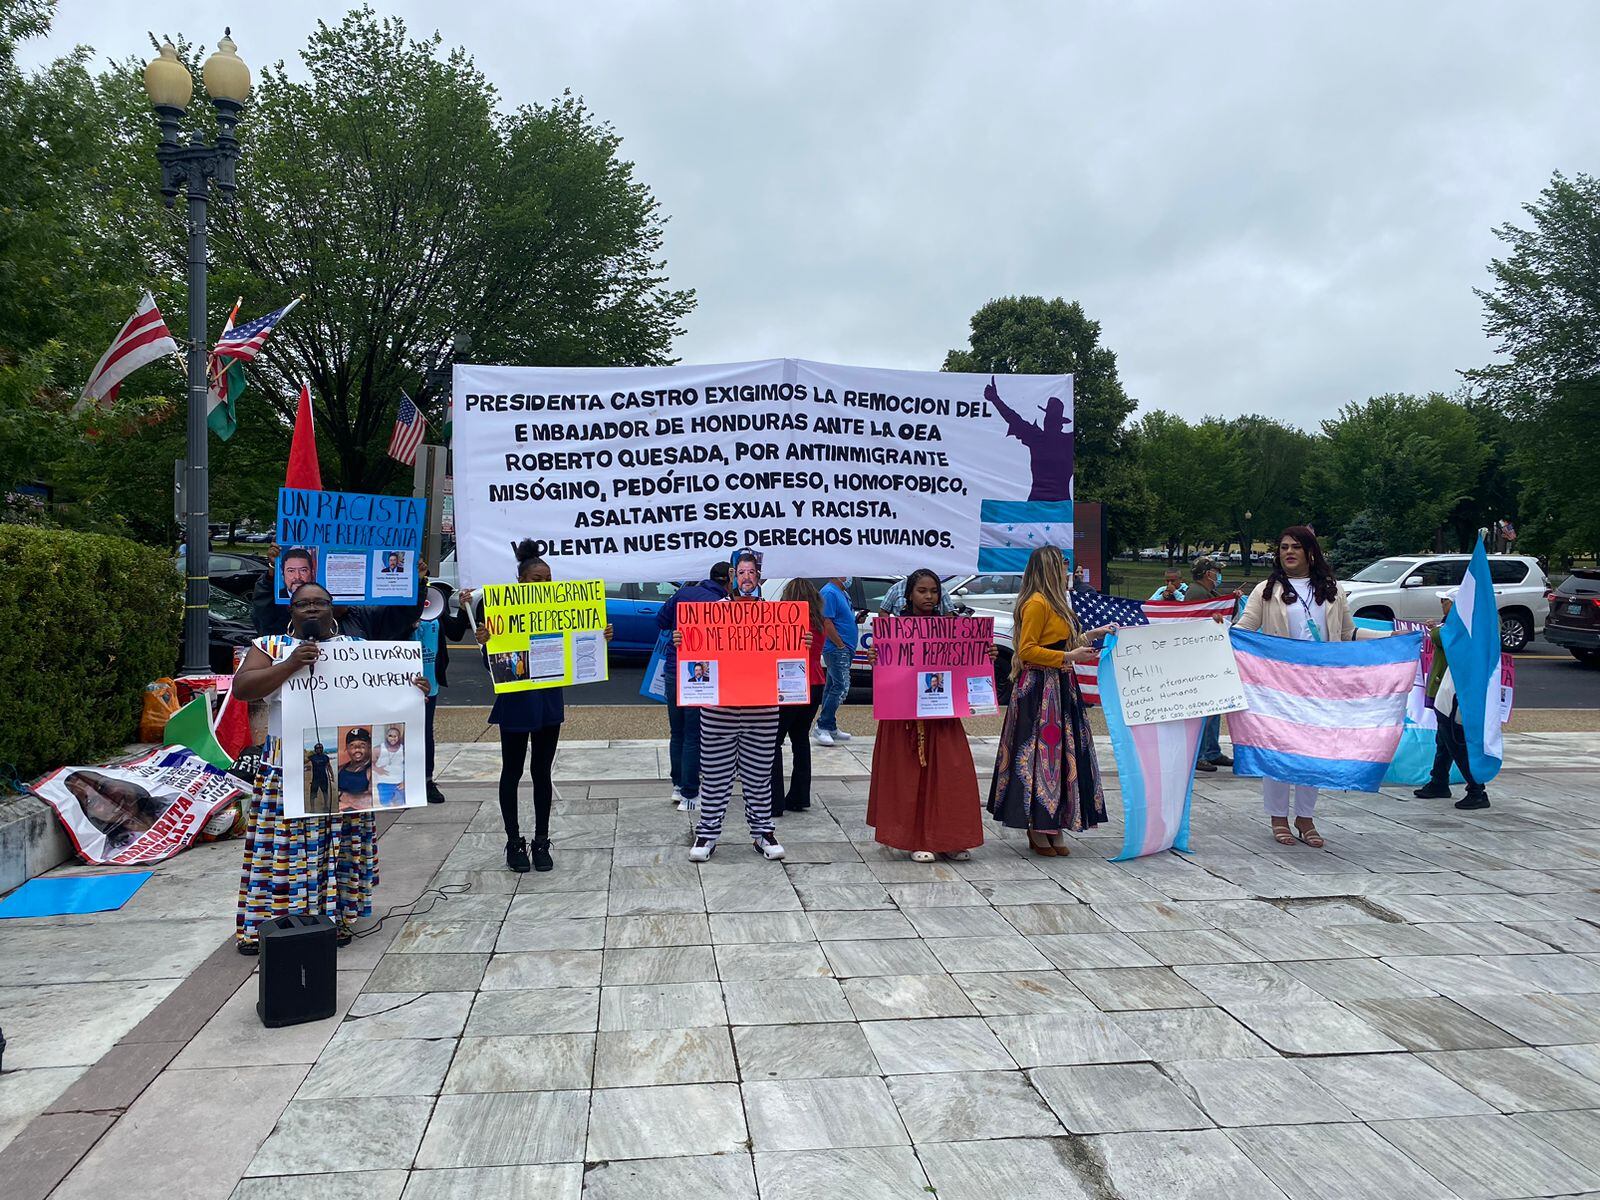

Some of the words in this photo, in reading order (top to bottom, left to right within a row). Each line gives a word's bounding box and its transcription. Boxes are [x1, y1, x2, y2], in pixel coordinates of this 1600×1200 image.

[465, 393, 606, 411] PRESIDENTA
[610, 388, 699, 410] CASTRO
[704, 383, 808, 404] EXIGIMOS
[813, 386, 838, 404] LA
[843, 390, 951, 416] REMOCION
[955, 401, 992, 418] DEL
[655, 417, 685, 435] DE
[691, 413, 808, 433] HONDURAS
[812, 417, 865, 435] ANTE
[870, 420, 896, 438] LA
[898, 424, 942, 441] OEA
[505, 449, 613, 472] ROBERTO
[617, 444, 730, 467] QUESADA,
[735, 442, 780, 461] POR
[785, 443, 950, 467] ANTIINMIGRANTE
[489, 477, 607, 502] MISÓGINO,
[613, 469, 720, 497] PEDÓFILO
[724, 472, 830, 494] CONFESO,
[833, 473, 968, 496] HOMOFOBICO,
[281, 490, 310, 517] UN
[316, 491, 419, 525] RACISTA
[574, 503, 698, 528] ASALTANTE
[703, 500, 786, 520] SEXUAL
[791, 500, 806, 517] Y
[812, 501, 897, 519] RACISTA,
[281, 518, 308, 543] NO
[313, 523, 332, 544] ME
[336, 522, 417, 548] REPRESENTA
[510, 537, 619, 558] VOLENTA
[623, 530, 738, 553] NUESTROS
[744, 528, 853, 547] DERECHOS
[857, 529, 955, 549] HUMANOS.
[483, 587, 500, 607] UN
[503, 580, 602, 607] ANTIINMIGRANTE
[486, 614, 505, 635] NO
[508, 613, 526, 634] ME
[678, 602, 699, 624] UN
[678, 626, 703, 651] NO
[706, 626, 724, 651] ME
[728, 624, 809, 651] REPRESENTA
[873, 616, 891, 639] UN
[895, 616, 957, 639] ASALTANTE
[333, 647, 360, 662] LOS
[362, 645, 421, 661] LLEVARON
[874, 642, 893, 666] NO
[897, 642, 914, 666] ME
[922, 641, 993, 667] REPRESENTA
[1115, 643, 1142, 658] LEY
[1151, 640, 1167, 650] DE
[1173, 634, 1225, 647] IDENTIDAD
[288, 675, 329, 691] VIVOS
[334, 675, 359, 690] LOS
